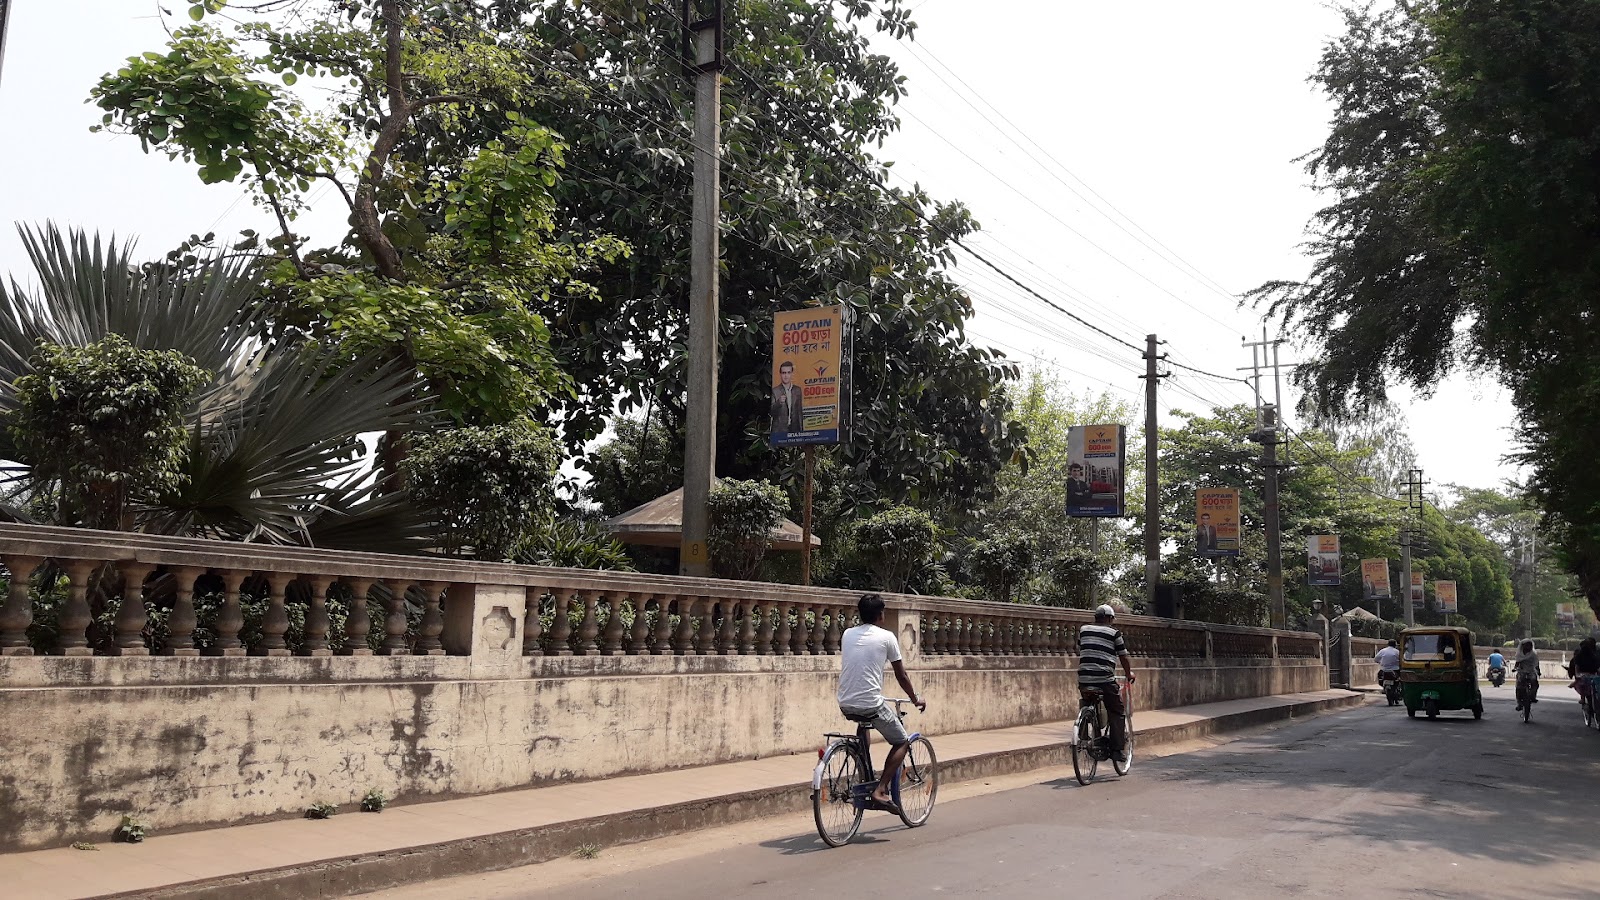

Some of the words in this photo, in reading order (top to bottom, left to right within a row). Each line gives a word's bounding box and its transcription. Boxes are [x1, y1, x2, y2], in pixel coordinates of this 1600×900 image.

[783, 318, 832, 332] CAPTAIN
[782, 329, 809, 345] 600
[810, 328, 831, 341] ছাড়া
[782, 344, 800, 355] কথা
[802, 343, 818, 353] হবে
[821, 341, 831, 351] না
[804, 376, 836, 385] CAPTAIN
[803, 386, 820, 397] 600
[692, 543, 699, 555] 8
